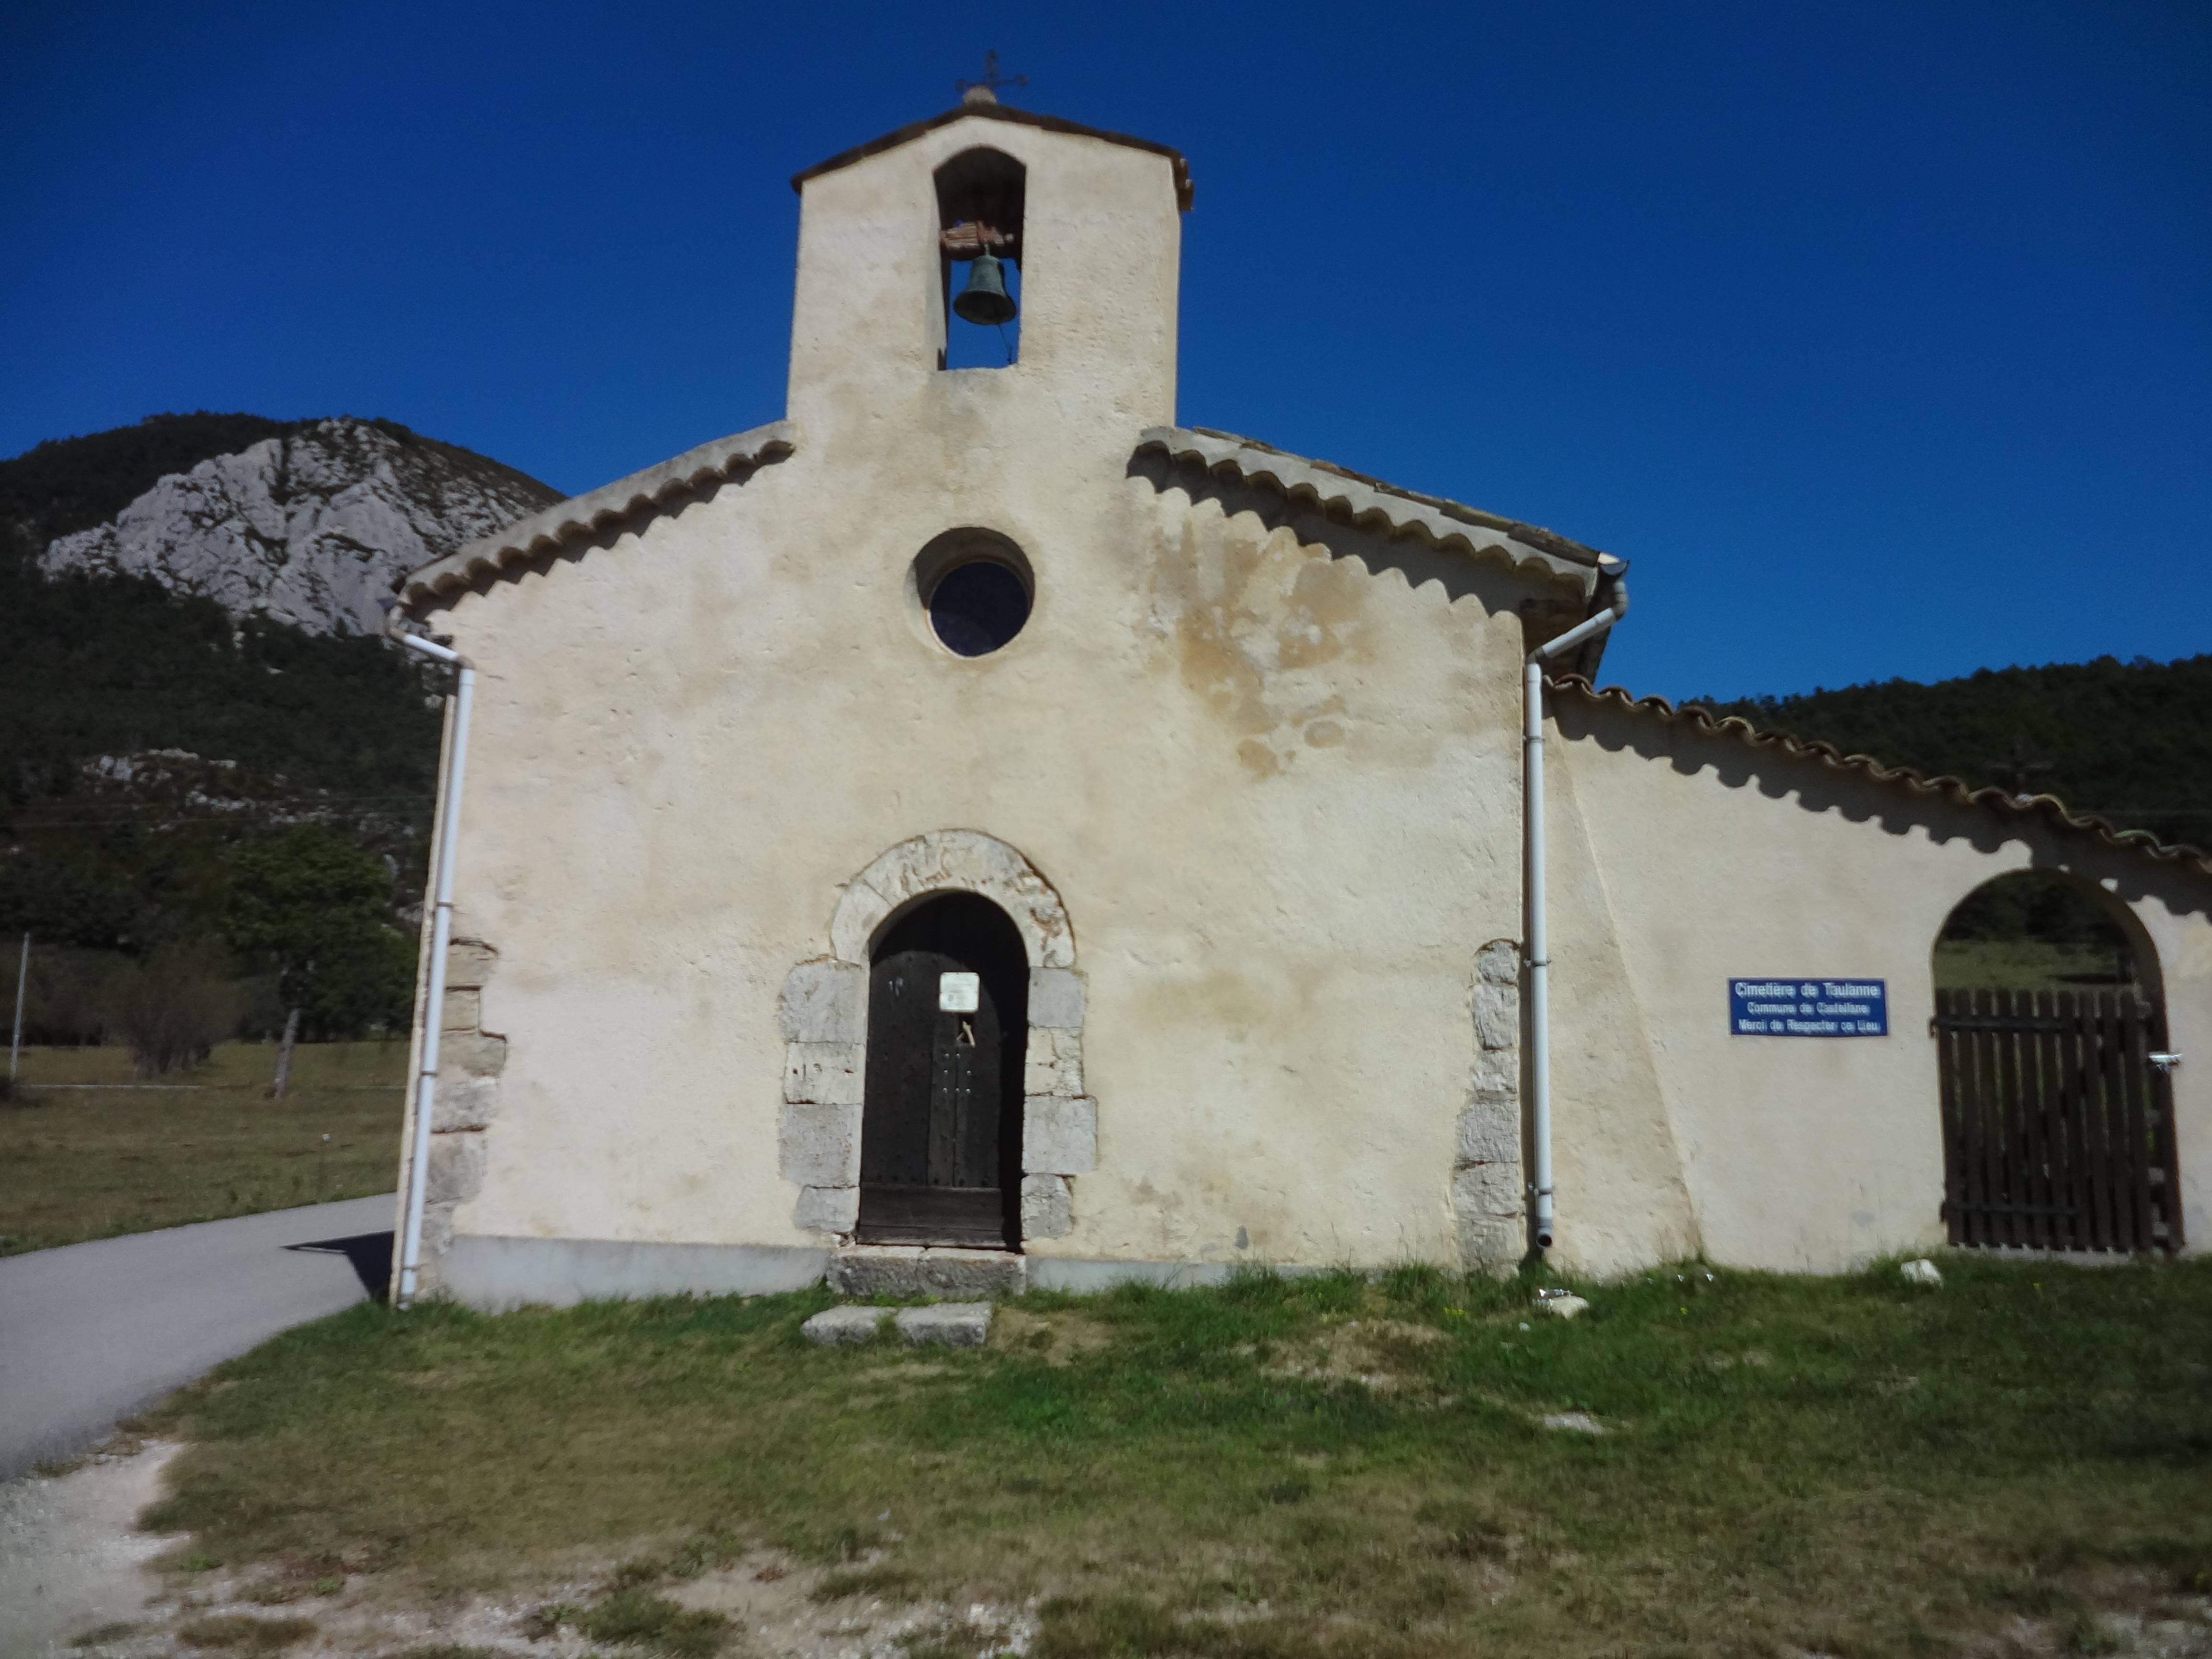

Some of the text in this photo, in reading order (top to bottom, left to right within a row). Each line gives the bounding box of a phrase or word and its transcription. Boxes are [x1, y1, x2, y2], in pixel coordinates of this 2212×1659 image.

[1735, 982, 1880, 998] Cimetière de Taulanne
[1747, 1002, 1870, 1015] Commune de Castellane
[1738, 1019, 1880, 1033] Merci de Respecter ce Lieu
